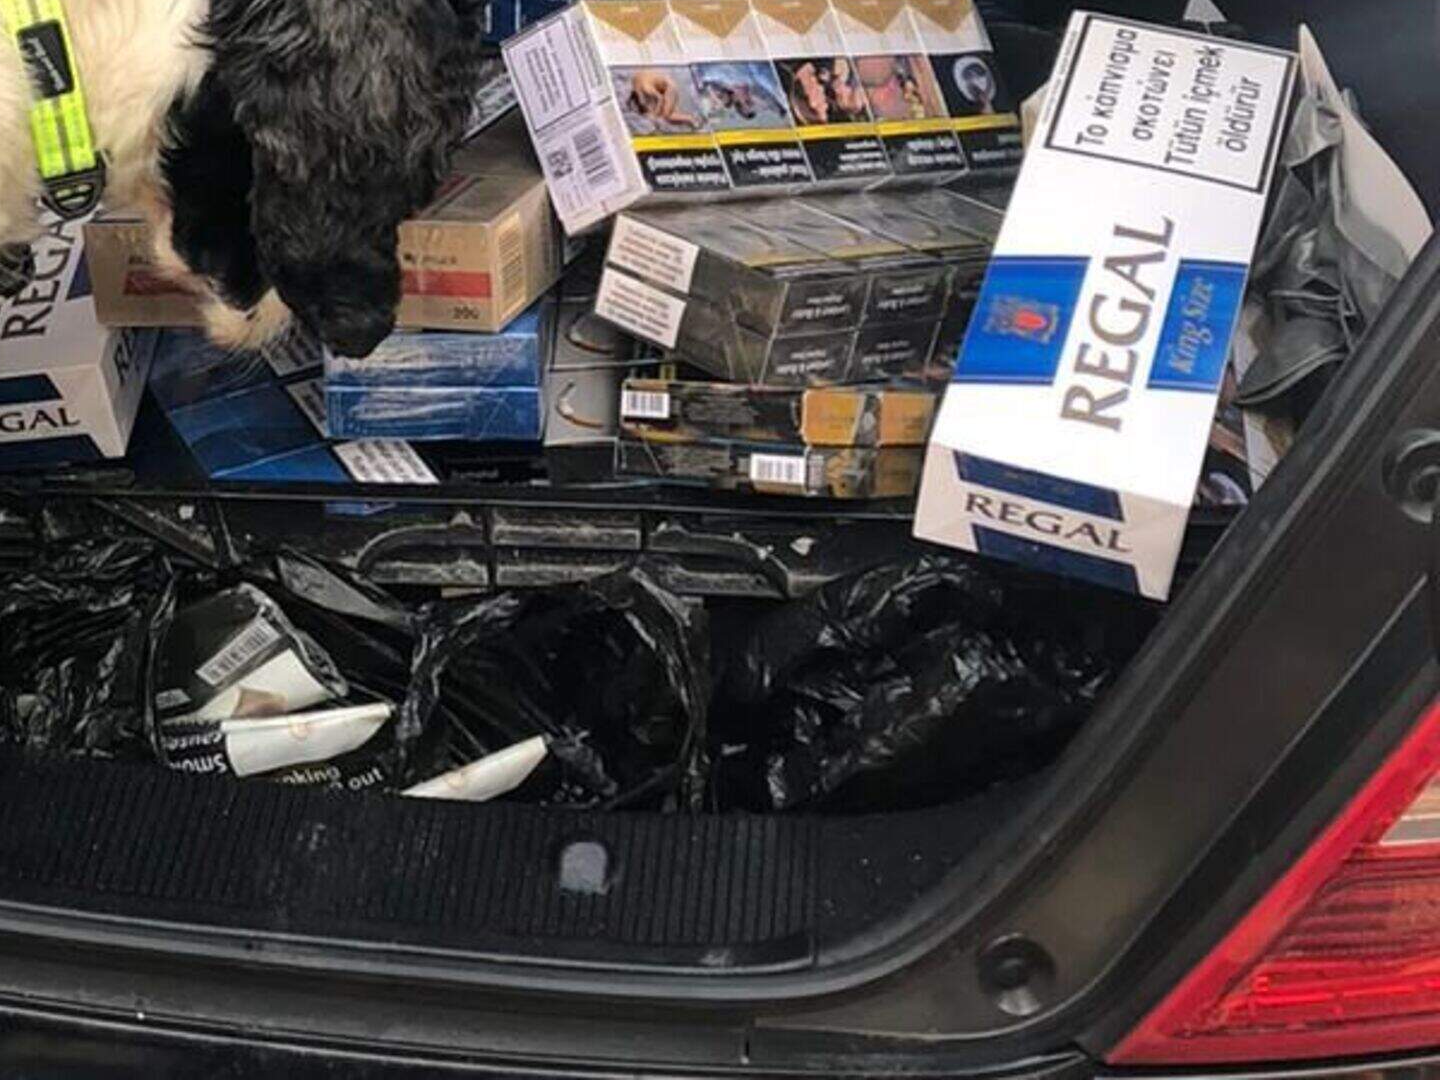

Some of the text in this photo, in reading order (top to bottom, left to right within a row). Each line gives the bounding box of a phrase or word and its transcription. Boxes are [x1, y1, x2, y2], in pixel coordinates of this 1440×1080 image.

[1163, 43, 1227, 165] Tütün içmek
[1215, 76, 1262, 153] öldürür
[0, 219, 76, 340] REGA
[1061, 215, 1175, 432] REGAL
[964, 491, 1135, 553] REGAL
[348, 766, 385, 791] out
